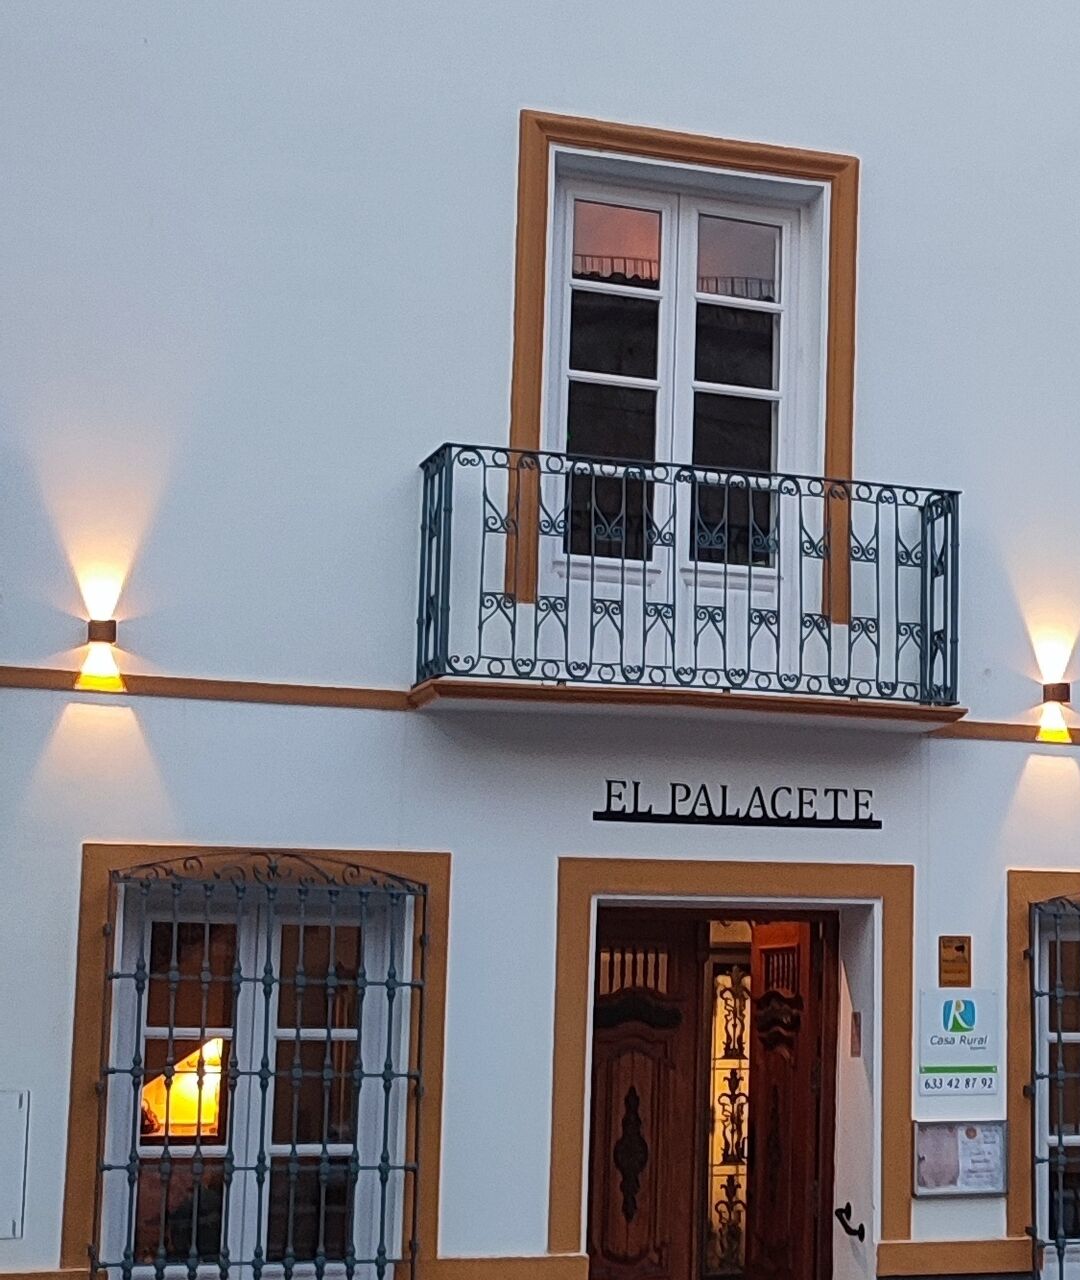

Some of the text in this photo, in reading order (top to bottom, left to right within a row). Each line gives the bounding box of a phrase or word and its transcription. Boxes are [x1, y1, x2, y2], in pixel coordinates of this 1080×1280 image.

[605, 780, 873, 820] EL PALACETE
[930, 1035, 988, 1045] Casa Rural
[925, 1077, 993, 1089] 633 42 87 92
